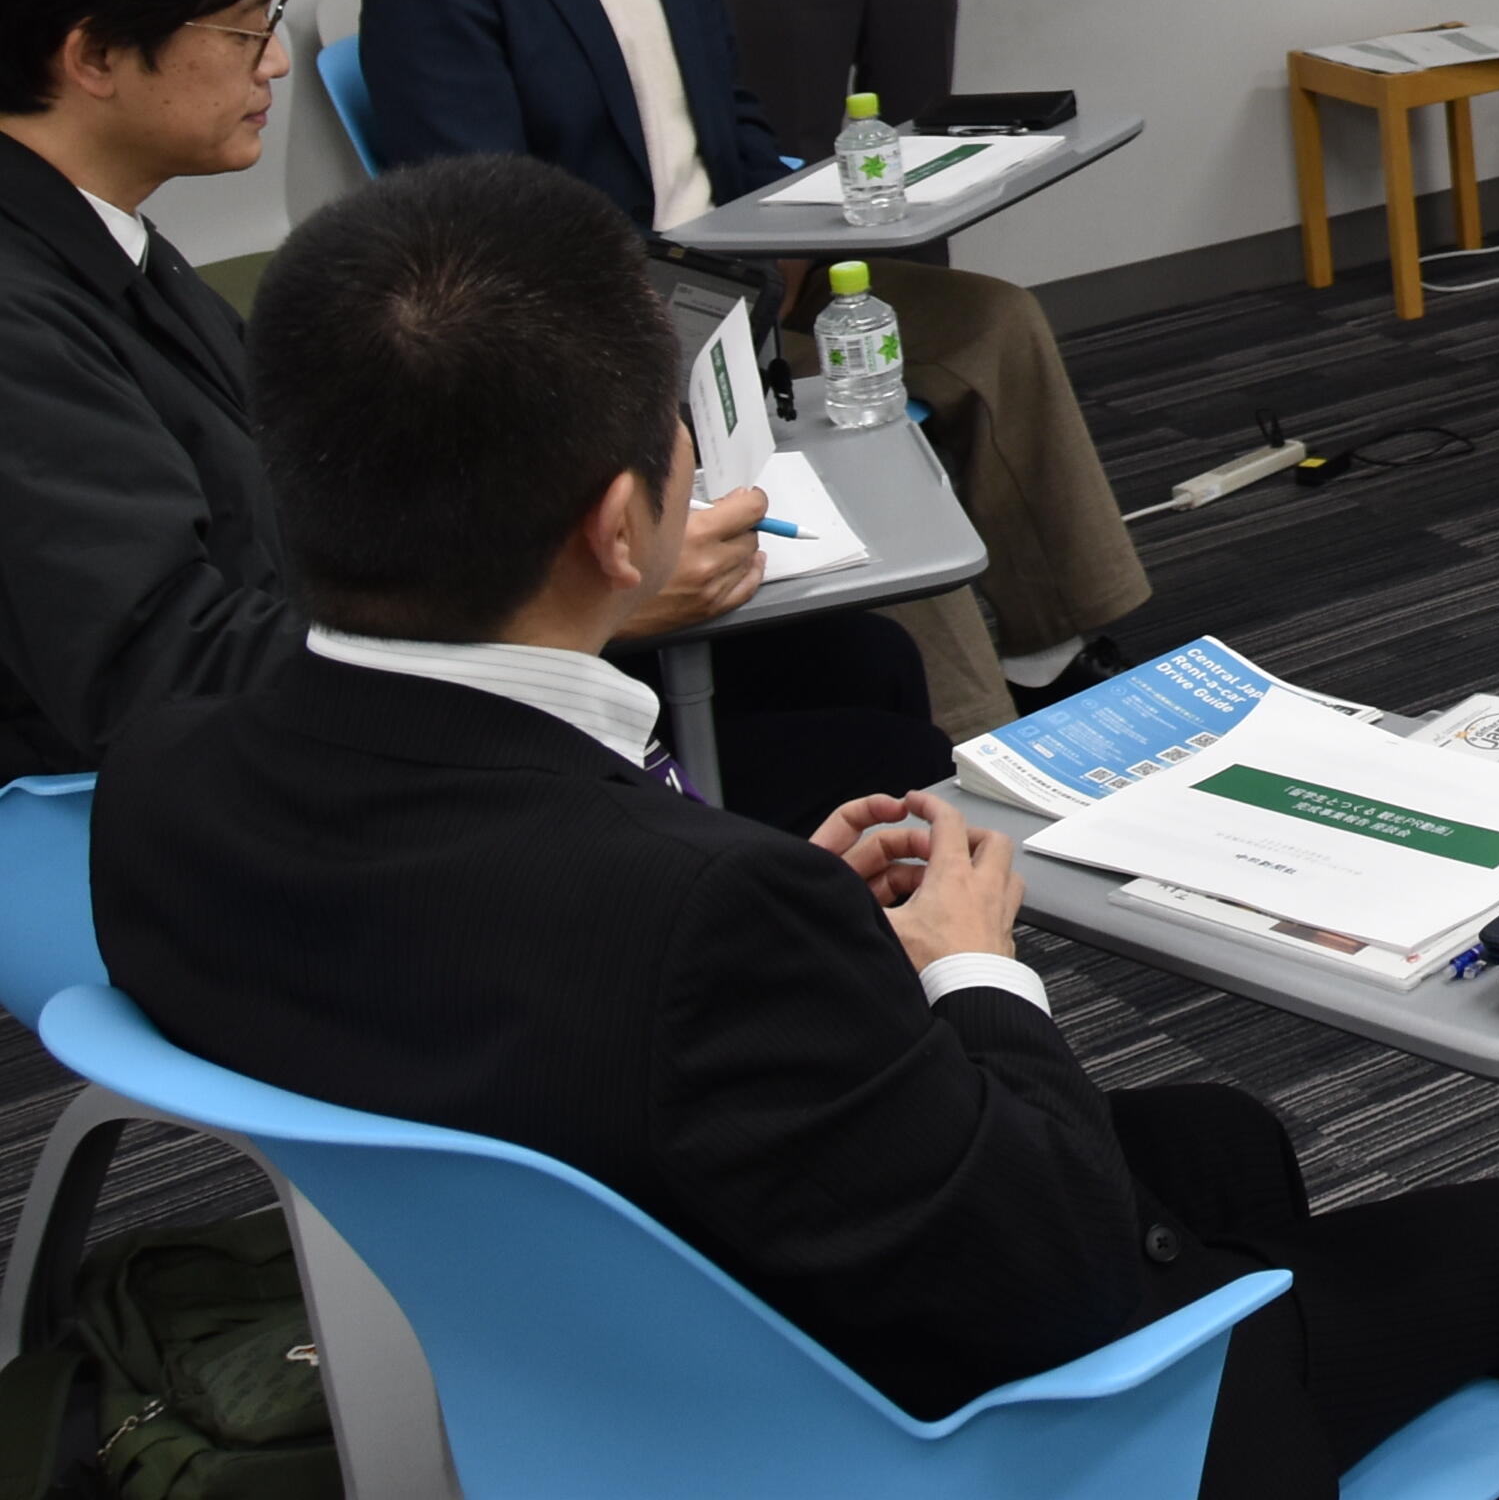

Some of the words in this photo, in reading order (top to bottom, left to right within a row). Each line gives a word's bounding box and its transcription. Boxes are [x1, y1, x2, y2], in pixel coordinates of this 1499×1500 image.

[1155, 662, 1194, 690] Drive
[1193, 688, 1234, 713] Guide
[1171, 654, 1248, 703] Rent-a-car
[1187, 648, 1241, 685] Central
[1235, 683, 1265, 699] Jap
